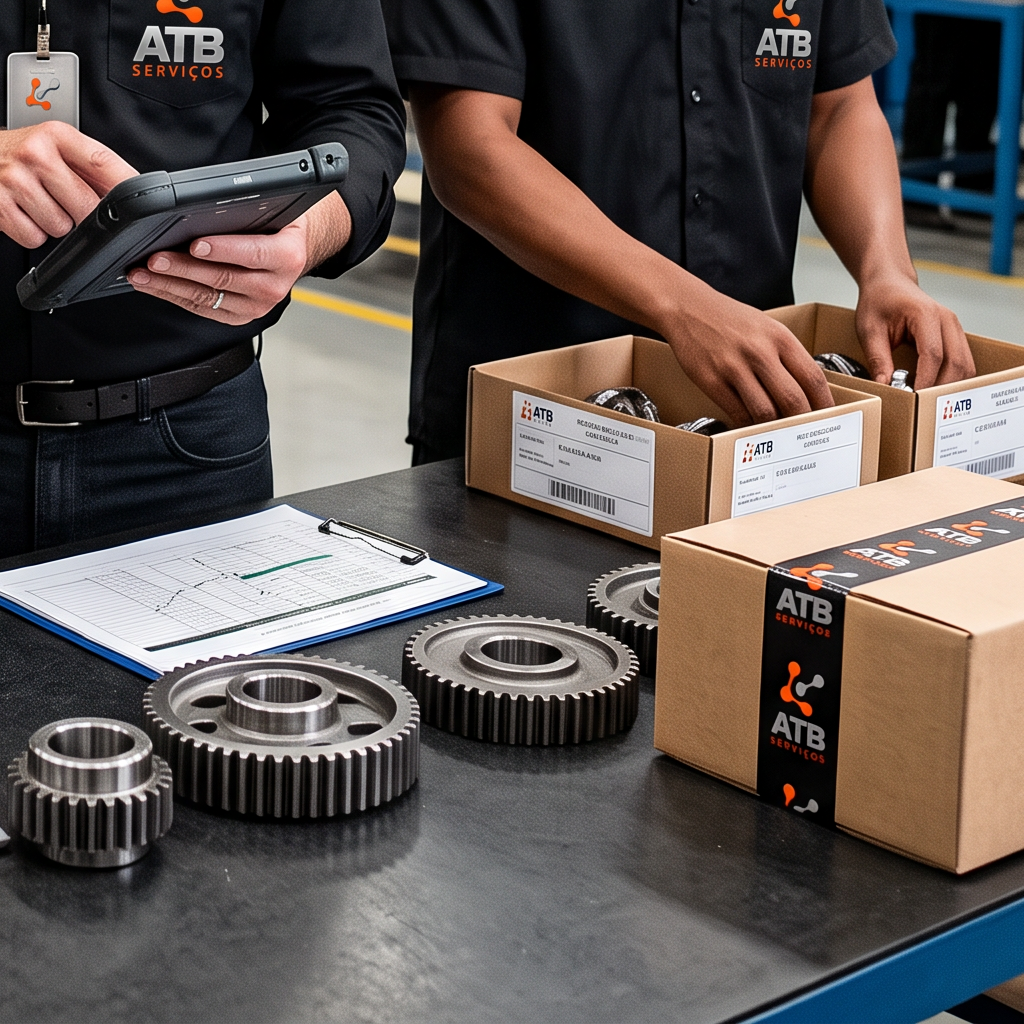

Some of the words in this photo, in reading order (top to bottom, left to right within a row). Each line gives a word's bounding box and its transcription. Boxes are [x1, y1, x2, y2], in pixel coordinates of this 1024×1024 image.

[132, 25, 225, 64] ATB
[755, 27, 812, 57] ATB
[132, 64, 224, 81] SERVIÇOS
[754, 57, 812, 70] SERVIÇOS
[533, 406, 554, 423] ATB
[953, 398, 972, 413] ATB
[754, 440, 773, 456] ATB
[924, 527, 982, 545] ATB
[776, 587, 833, 625] ATB
[775, 612, 831, 638] SERVIÇOS
[771, 711, 826, 752] ATB
[770, 736, 825, 764] SERVIÇOS
